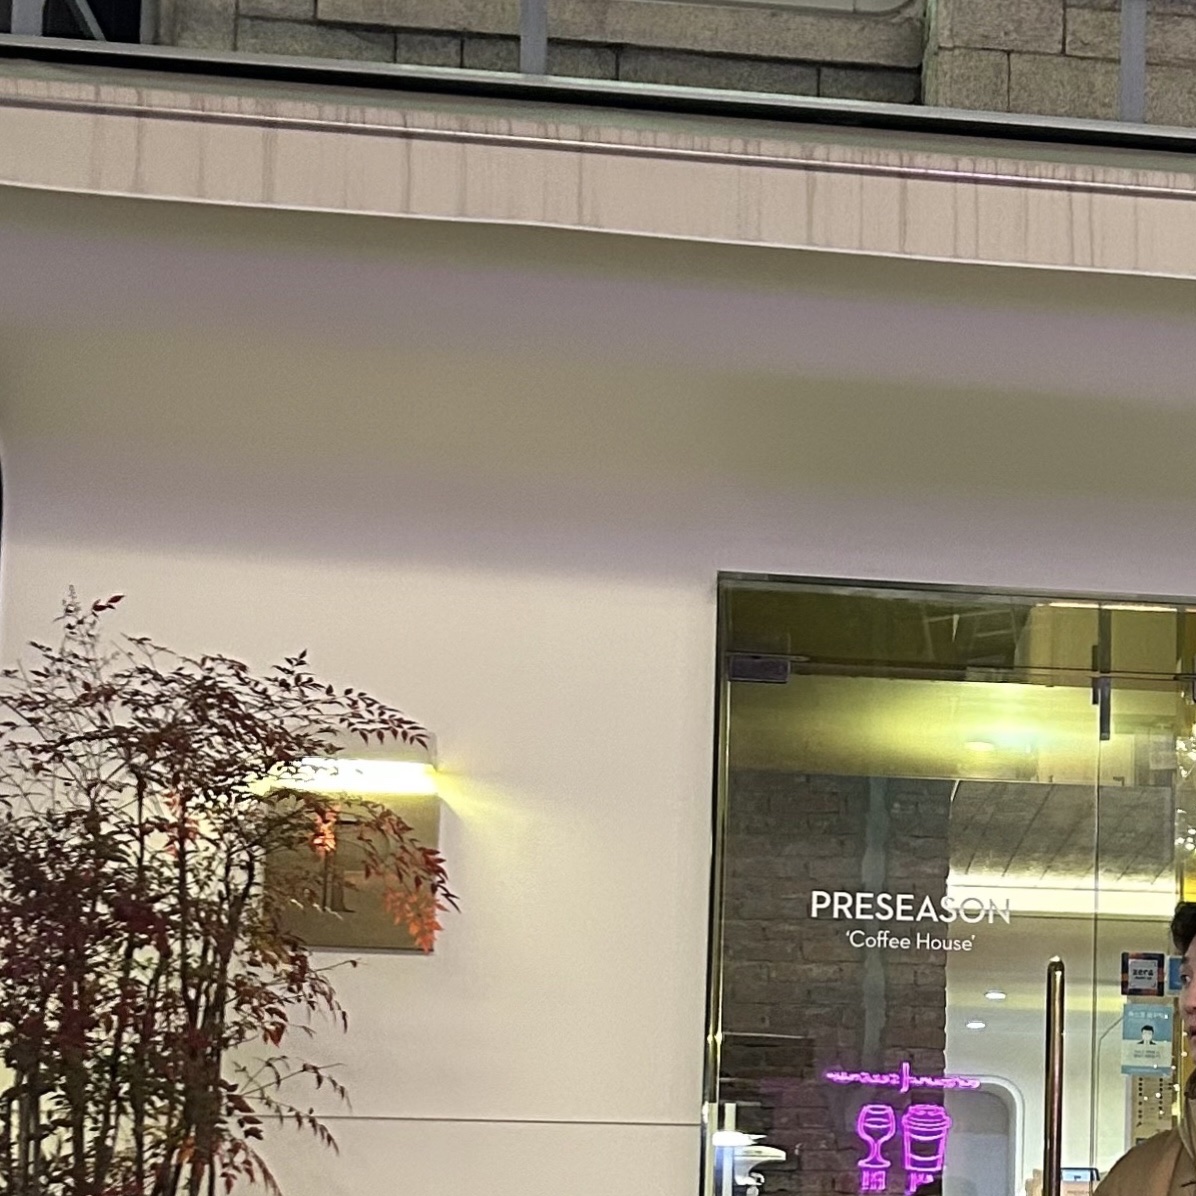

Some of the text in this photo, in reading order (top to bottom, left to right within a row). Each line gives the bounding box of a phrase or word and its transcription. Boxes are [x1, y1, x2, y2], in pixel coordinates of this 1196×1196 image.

[810, 890, 1010, 924] PRESEASON
[845, 929, 976, 951] 'Coffee House'
